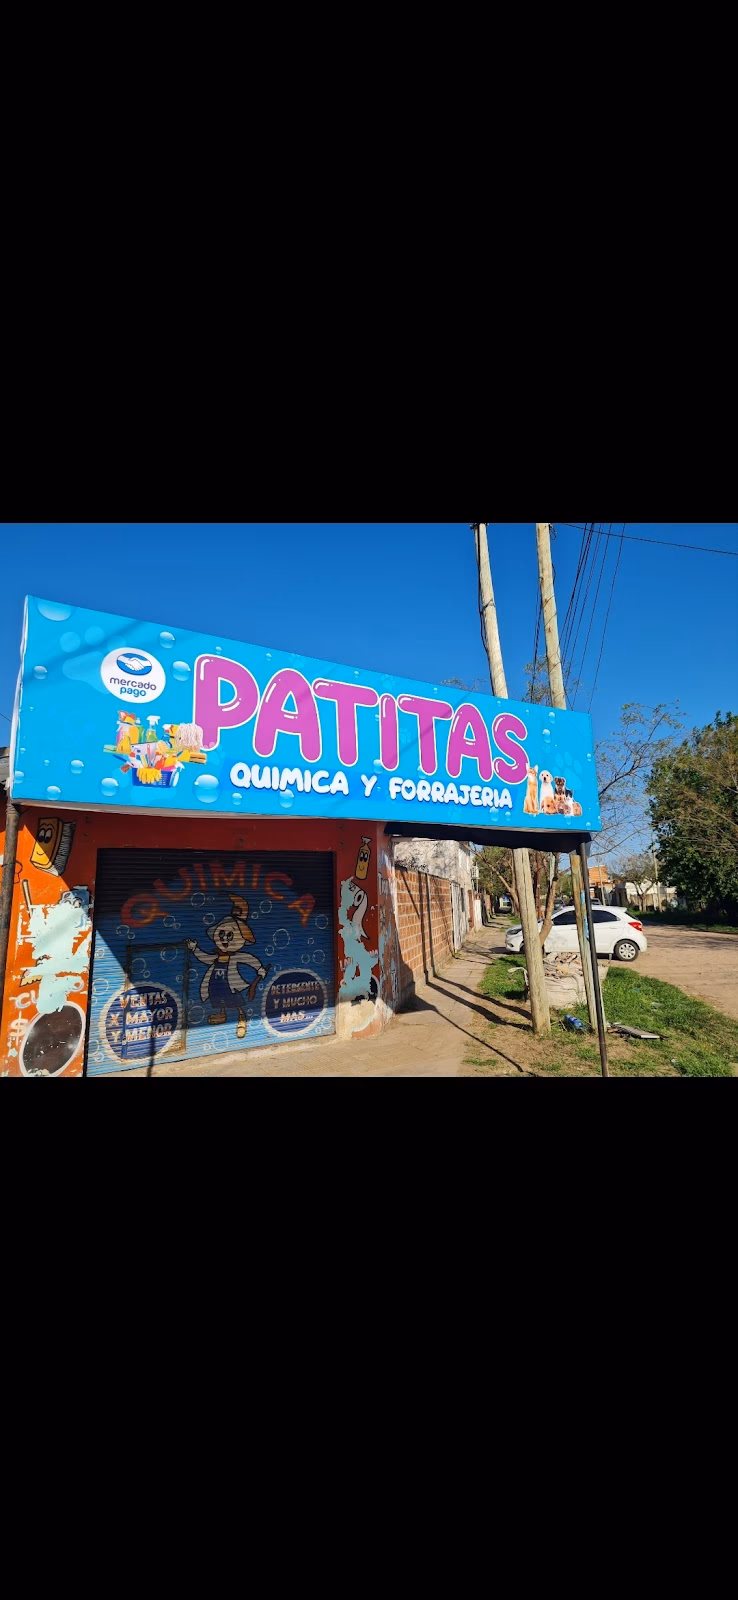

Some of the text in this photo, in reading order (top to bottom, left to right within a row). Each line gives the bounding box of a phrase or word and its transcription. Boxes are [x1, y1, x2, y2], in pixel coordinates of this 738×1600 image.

[109, 677, 157, 691] mercado
[119, 686, 147, 698] pago
[193, 654, 529, 784] PATITAS
[229, 762, 513, 809] QUIMICA Y FORRAJERIA
[120, 861, 316, 929] QUIMICA
[271, 980, 320, 996] DETERGENTE
[120, 991, 168, 1008] VENTAS
[273, 994, 318, 1010] Y MUCHO
[109, 1006, 174, 1027] X MAYOR
[111, 1022, 173, 1044] Y MENOR
